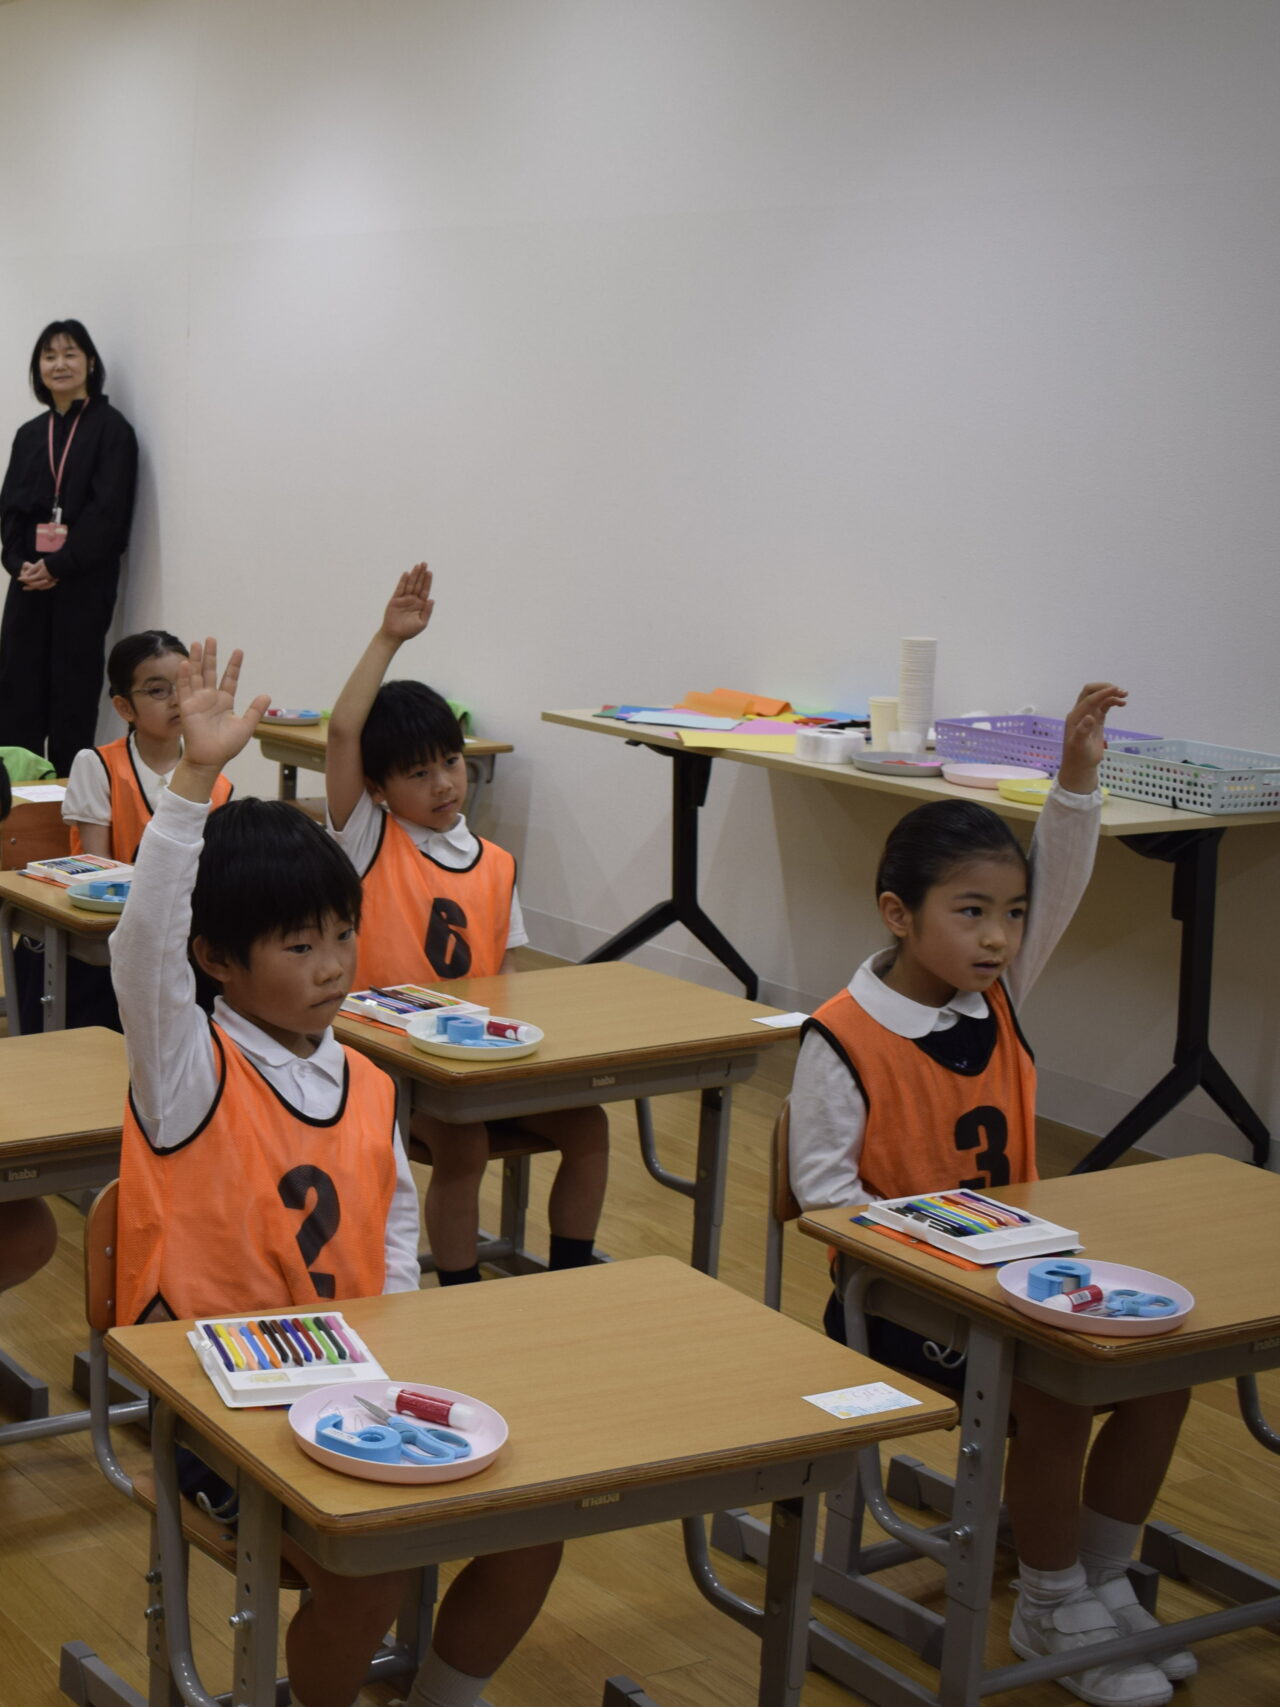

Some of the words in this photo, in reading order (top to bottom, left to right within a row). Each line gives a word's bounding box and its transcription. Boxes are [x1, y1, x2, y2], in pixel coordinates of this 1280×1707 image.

[424, 897, 472, 979] 6
[954, 1105, 1010, 1190] 3
[277, 1164, 340, 1299] 2
